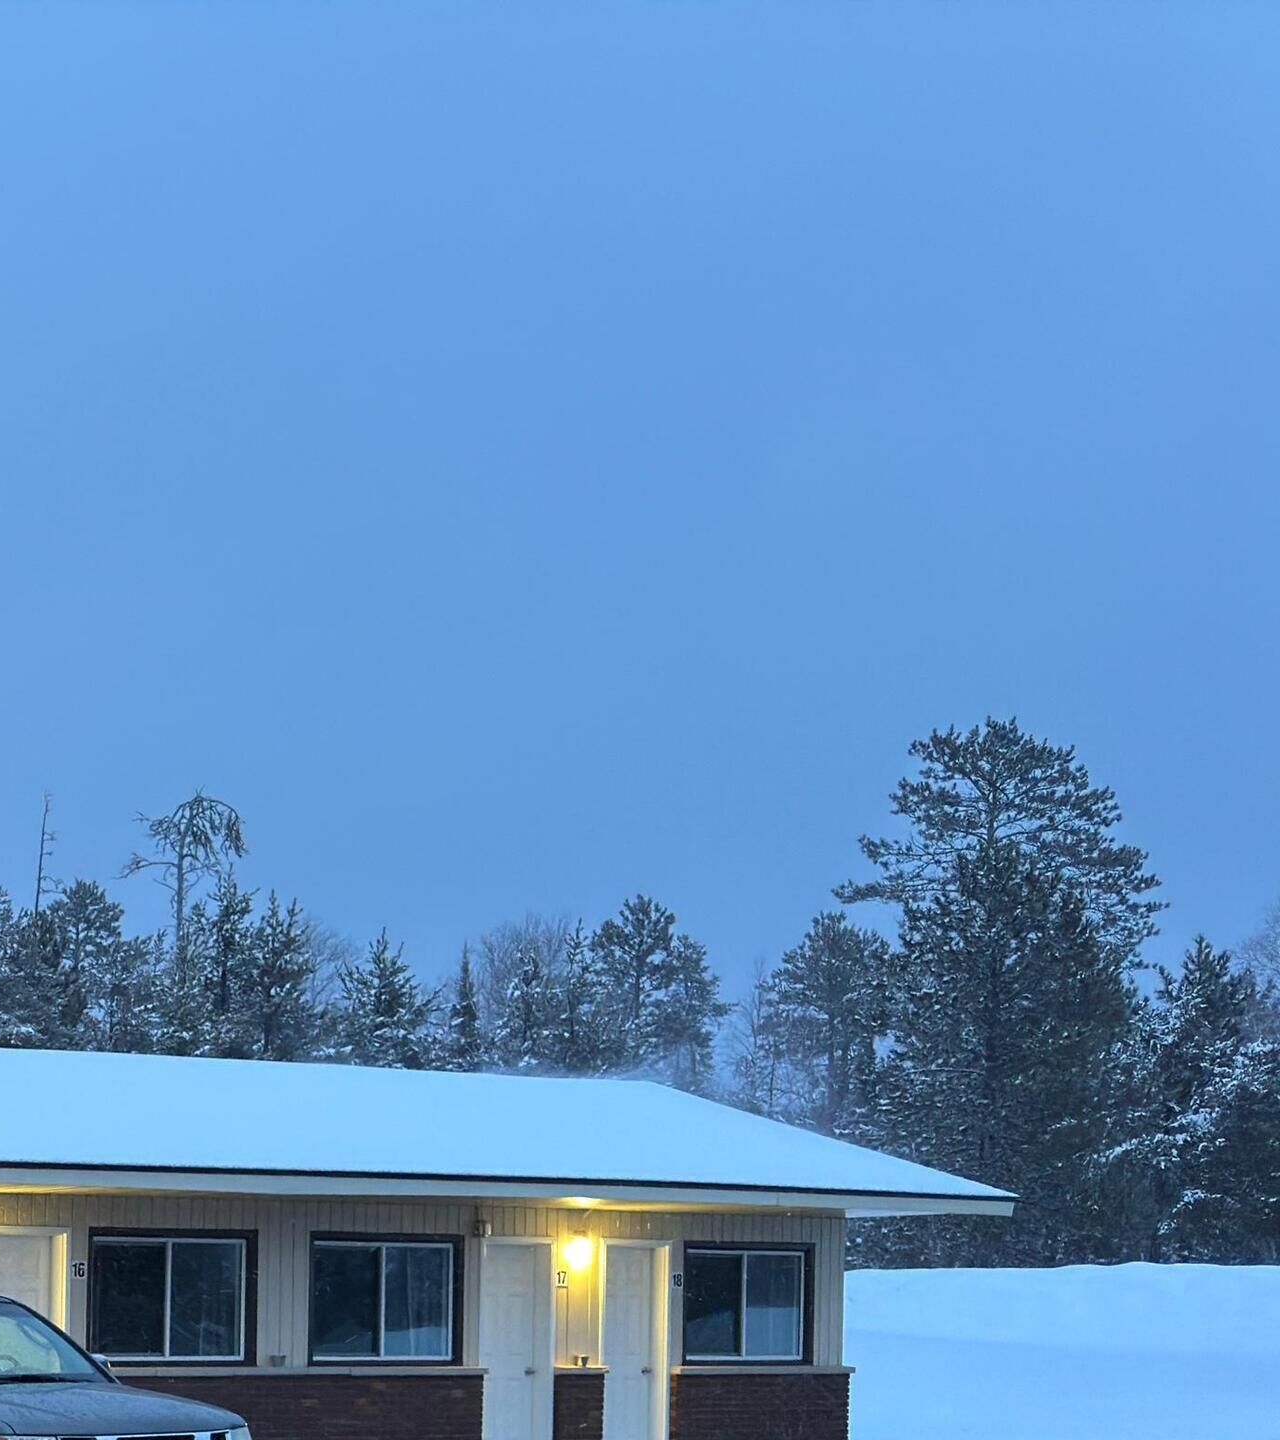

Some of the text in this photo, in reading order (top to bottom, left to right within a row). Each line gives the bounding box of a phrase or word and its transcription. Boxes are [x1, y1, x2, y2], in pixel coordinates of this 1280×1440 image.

[71, 1262, 86, 1278] 16
[556, 1270, 567, 1285] 17
[672, 1273, 683, 1288] 18
